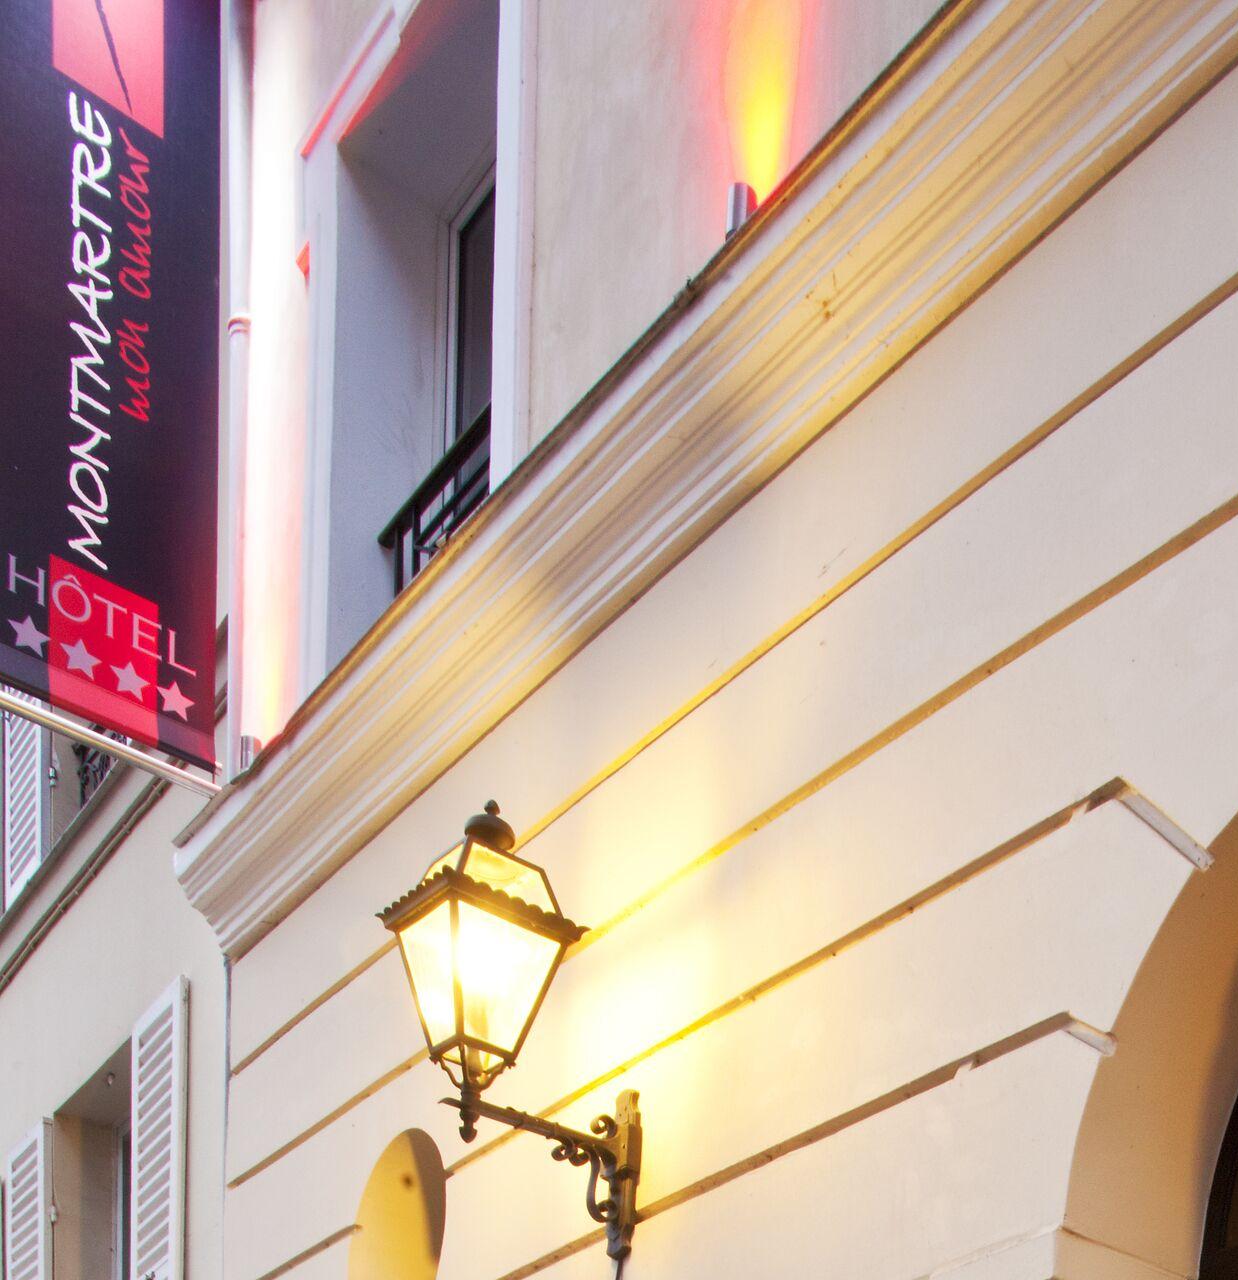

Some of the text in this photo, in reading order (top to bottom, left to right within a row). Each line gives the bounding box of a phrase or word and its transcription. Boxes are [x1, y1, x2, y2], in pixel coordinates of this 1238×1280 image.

[68, 92, 113, 571] MONTMARTRE
[118, 129, 151, 422] mon amour
[6, 554, 197, 678] HÔTEL
